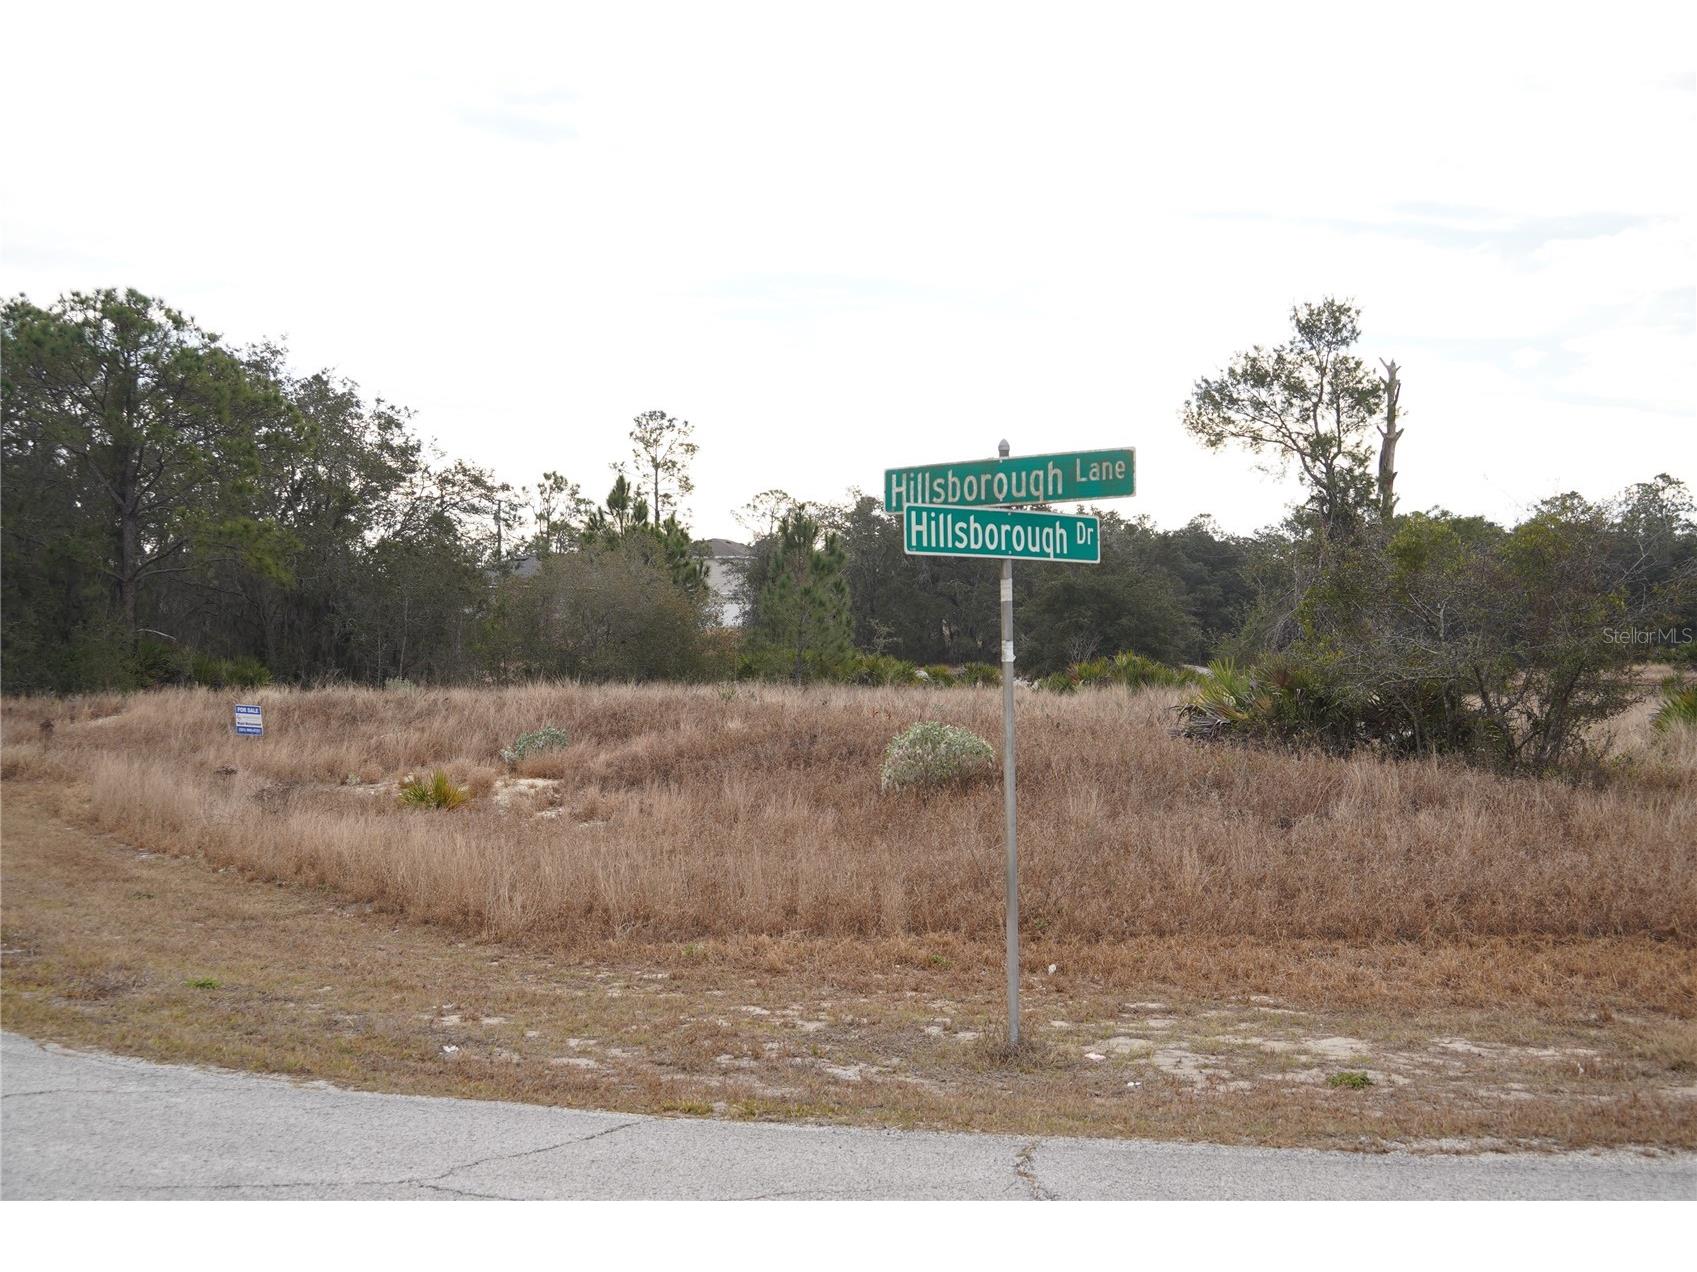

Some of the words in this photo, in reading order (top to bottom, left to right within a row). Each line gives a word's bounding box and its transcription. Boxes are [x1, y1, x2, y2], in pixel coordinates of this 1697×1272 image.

[891, 461, 1063, 507] Hillsborough
[1076, 458, 1126, 482] Lane
[911, 511, 1068, 559] Hillsborough
[1076, 522, 1094, 545] Dr
